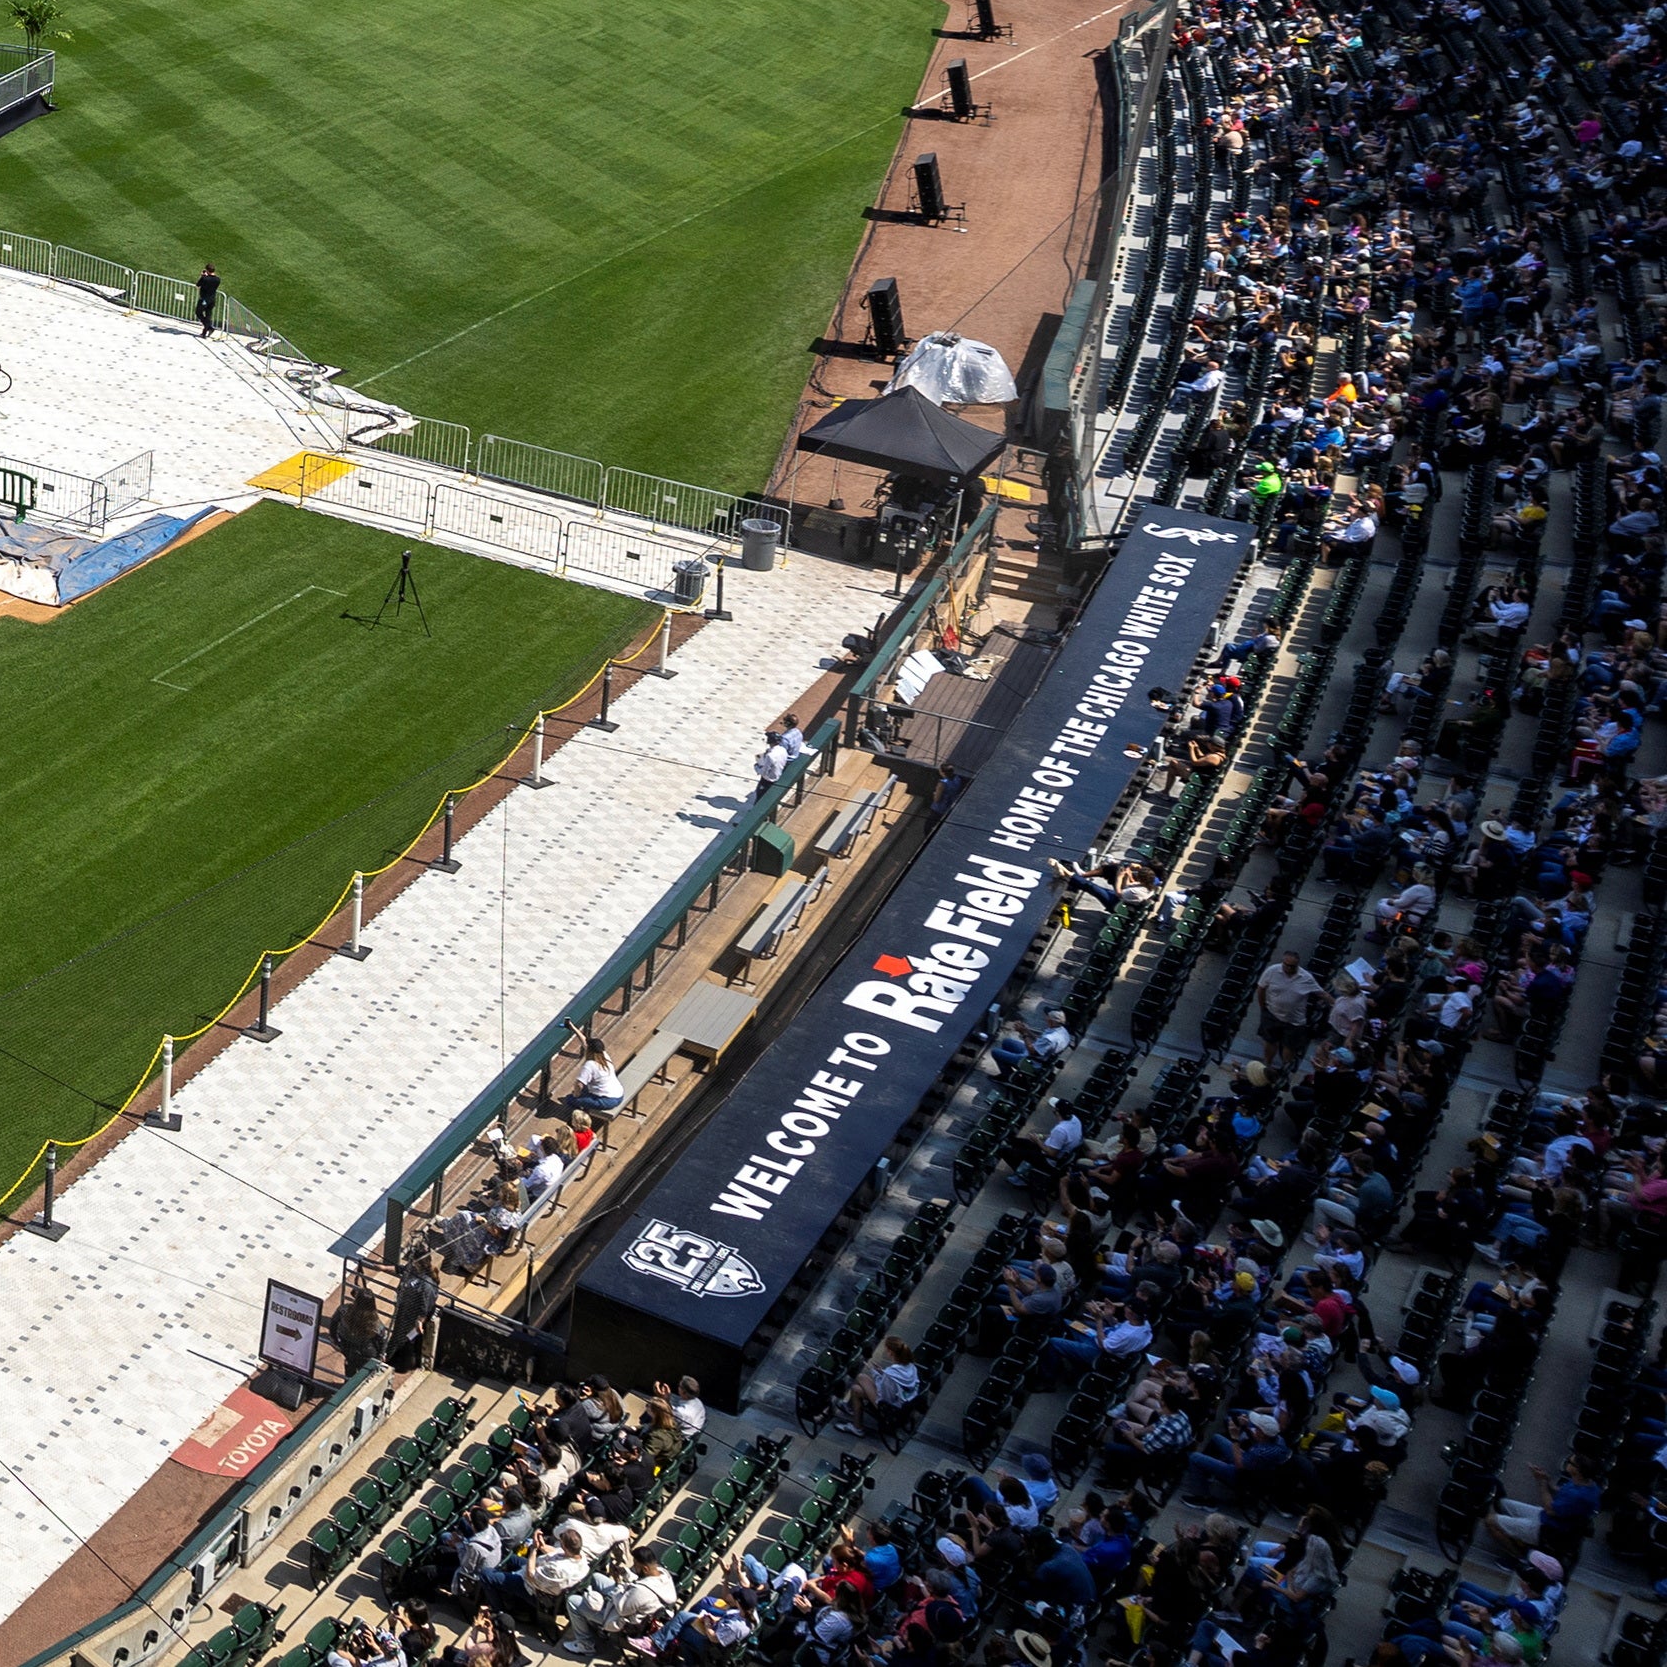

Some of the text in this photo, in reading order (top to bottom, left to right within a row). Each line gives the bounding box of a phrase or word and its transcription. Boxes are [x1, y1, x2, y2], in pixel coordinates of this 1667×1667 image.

[988, 551, 1197, 852] HOME OF THE CHICAGO WHITE SOX
[843, 854, 1041, 1033] Rate Field
[710, 1031, 892, 1221] WELCOME TO
[270, 1300, 314, 1327] RESTROOMS
[624, 1222, 717, 1286] 125
[218, 1418, 287, 1473] TOYOTA
